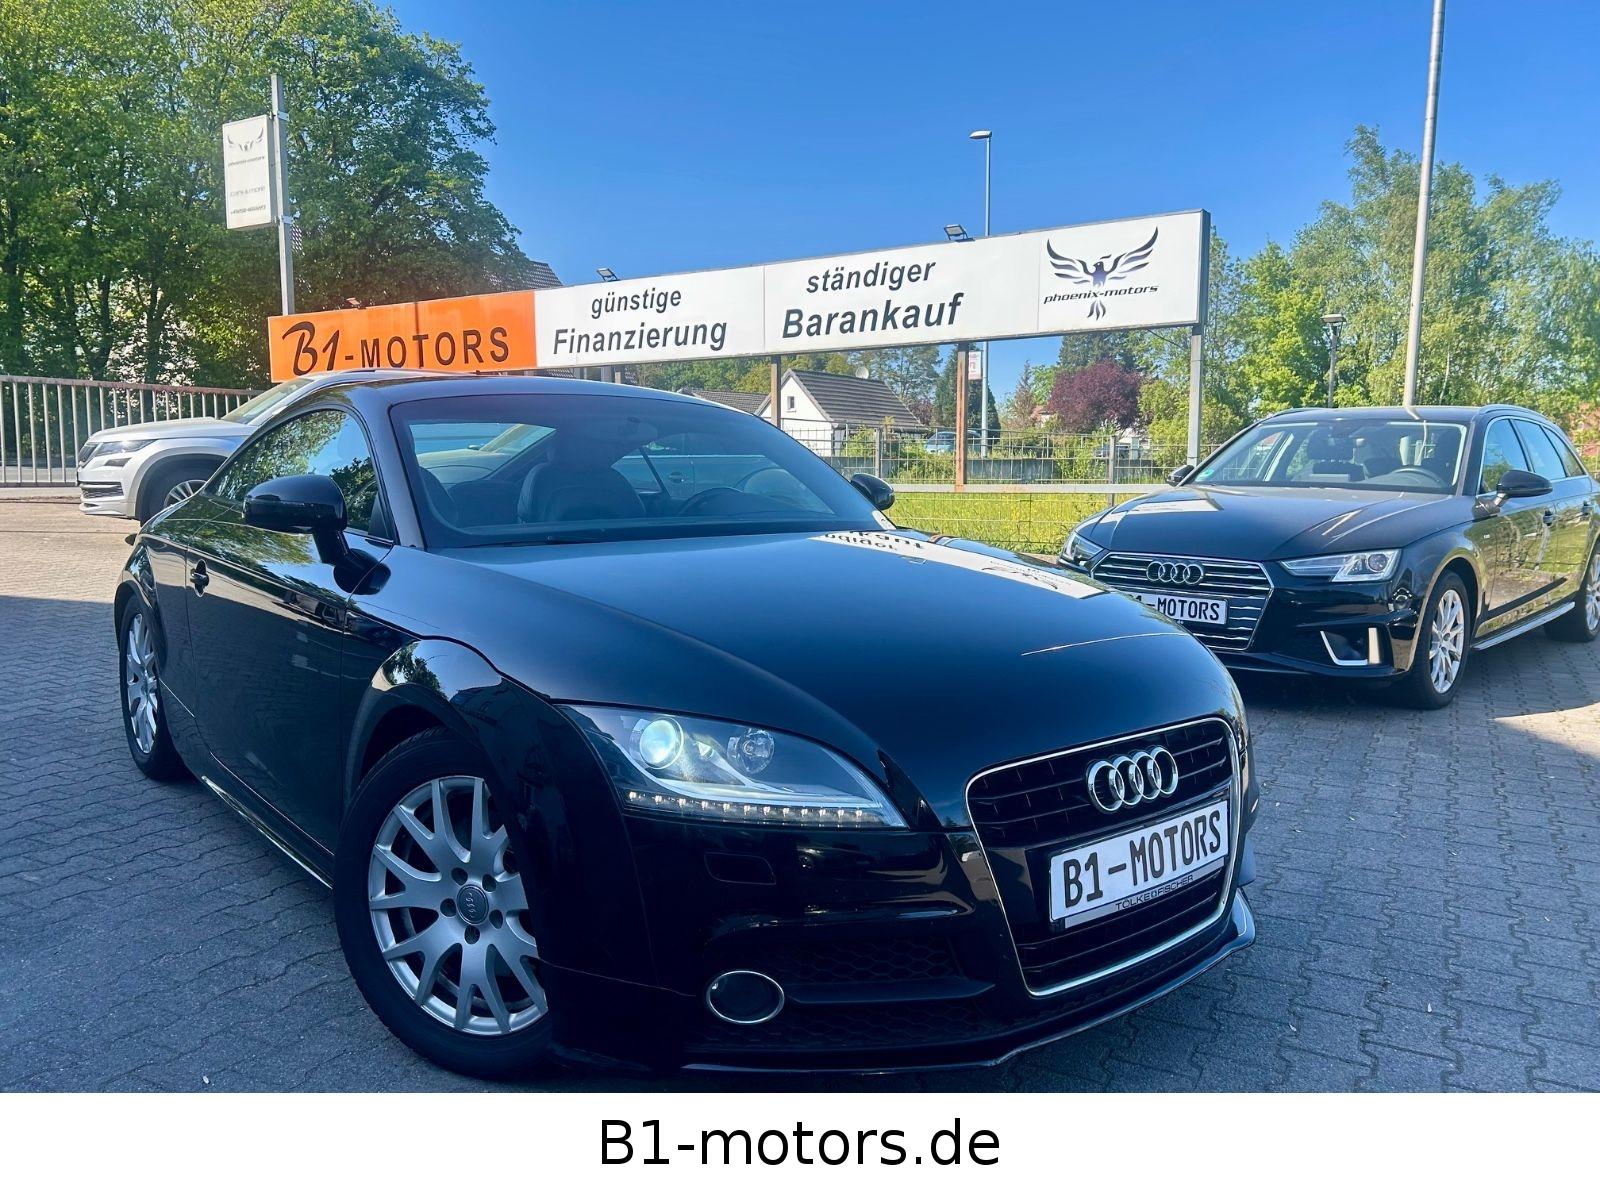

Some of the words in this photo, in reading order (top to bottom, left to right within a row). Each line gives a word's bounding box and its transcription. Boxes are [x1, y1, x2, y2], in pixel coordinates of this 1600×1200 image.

[806, 261, 936, 293] ständiger
[591, 287, 682, 319] günstige
[1043, 285, 1160, 304] phoenix-motors
[782, 292, 964, 339] Barankauf
[553, 321, 727, 354] Finanzierung
[1063, 810, 1221, 908] B1-MOTORS
